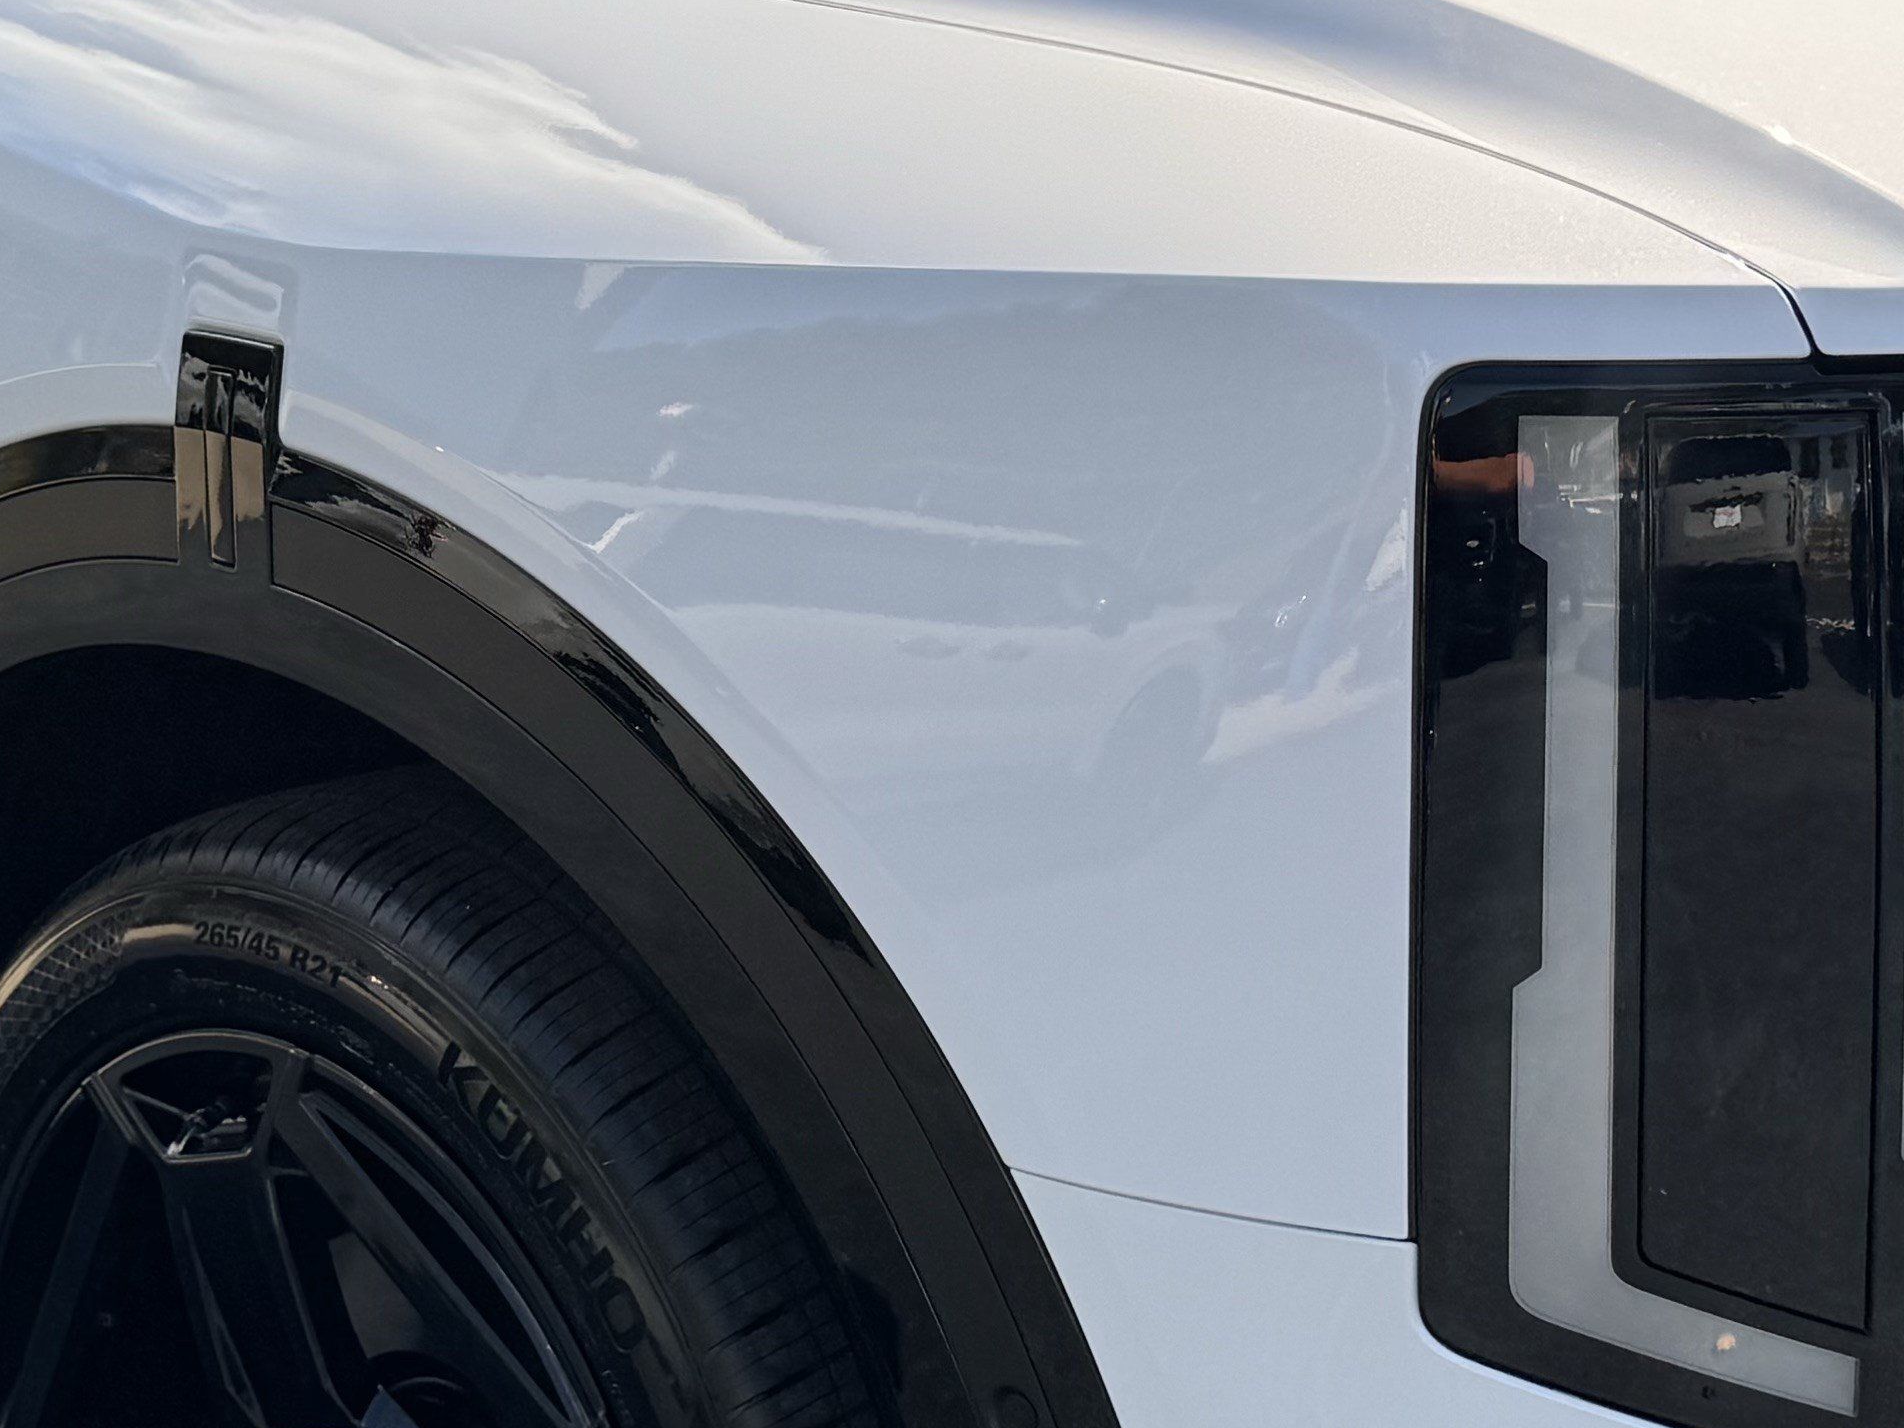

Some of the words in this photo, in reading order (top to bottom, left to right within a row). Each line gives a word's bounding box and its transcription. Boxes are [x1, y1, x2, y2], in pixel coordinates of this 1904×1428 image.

[195, 922, 282, 961] 265/45
[289, 946, 344, 988] R21
[438, 1041, 646, 1351] KUMHO
